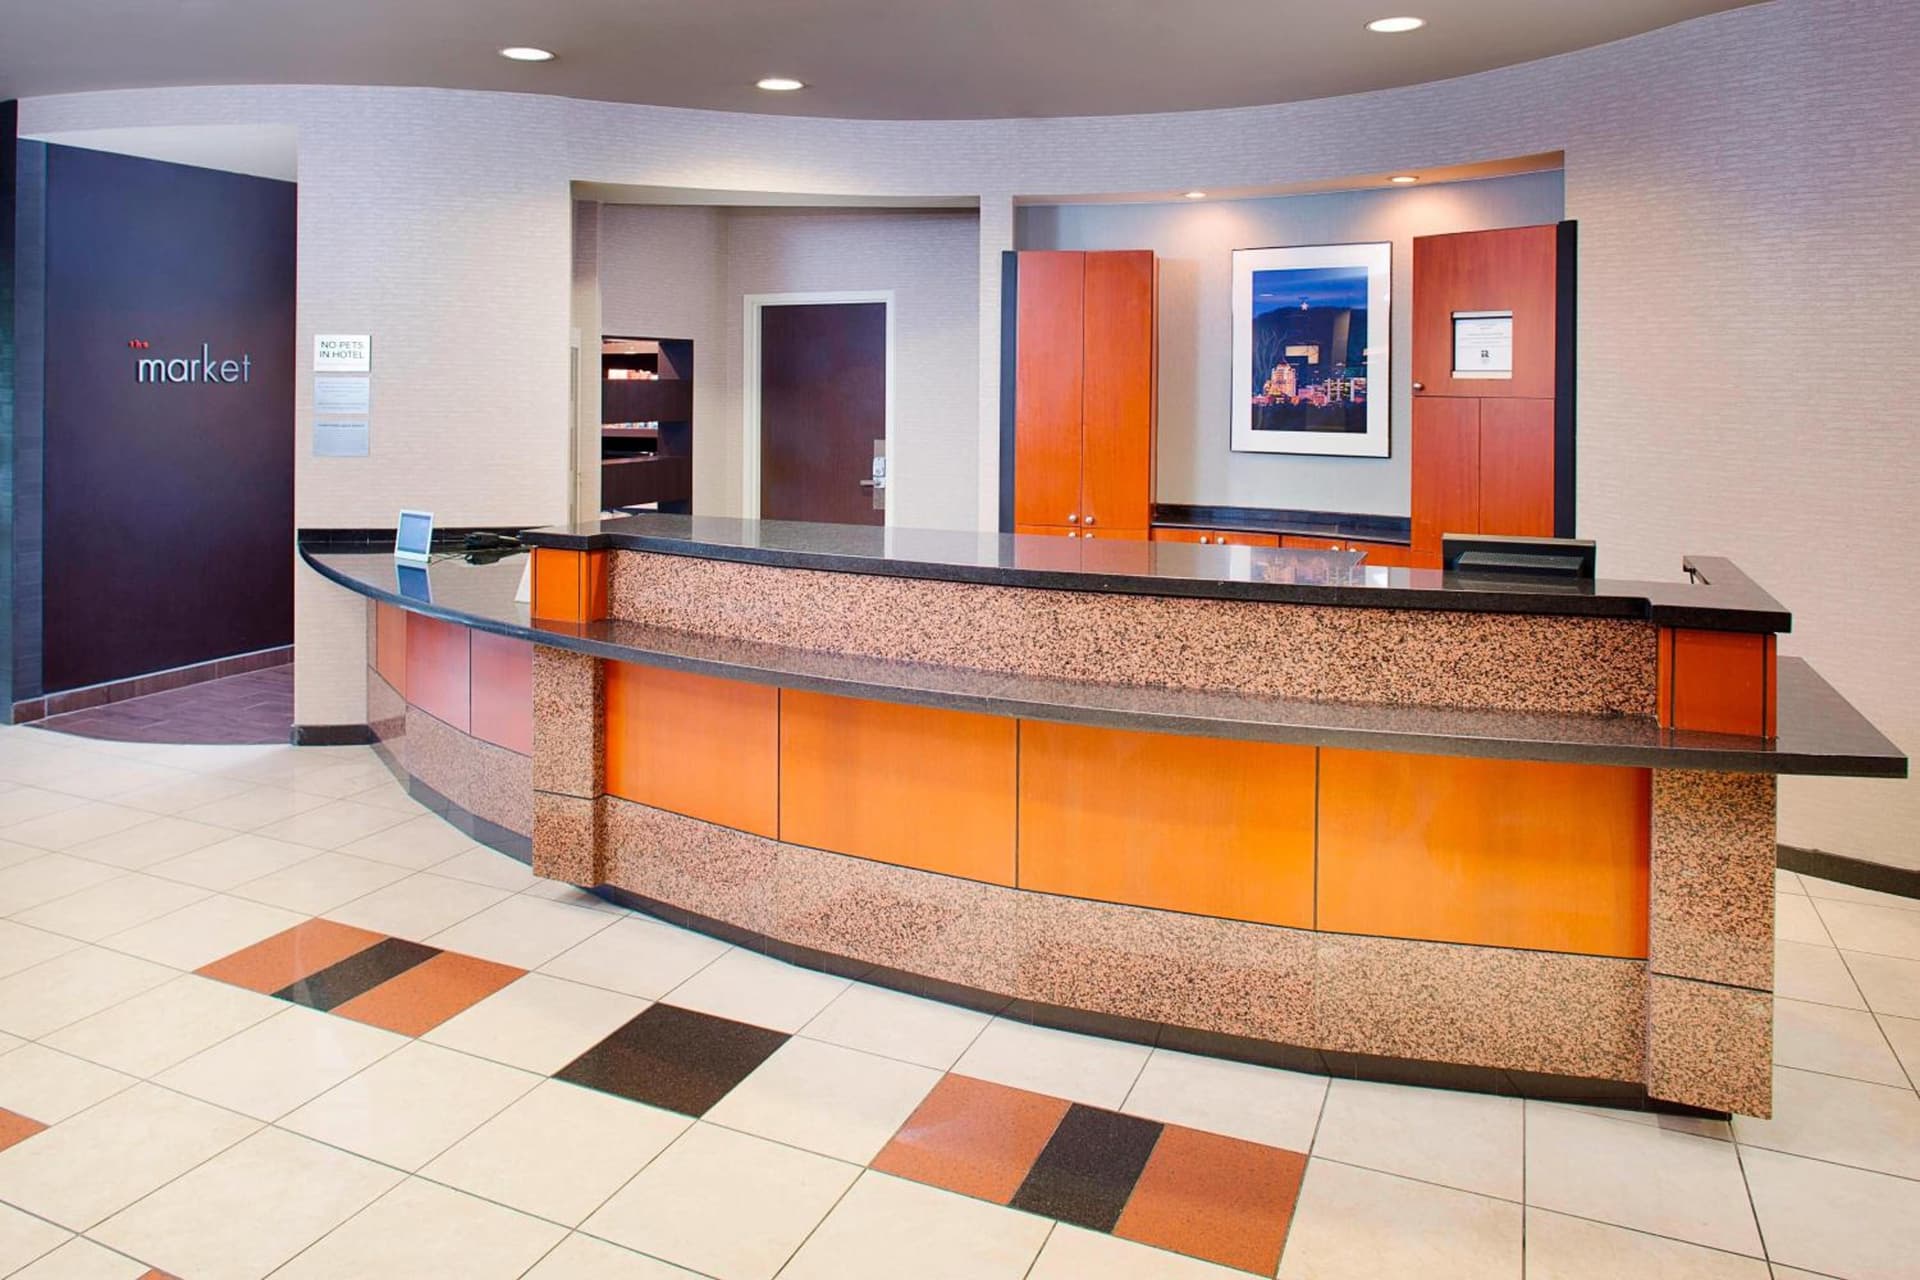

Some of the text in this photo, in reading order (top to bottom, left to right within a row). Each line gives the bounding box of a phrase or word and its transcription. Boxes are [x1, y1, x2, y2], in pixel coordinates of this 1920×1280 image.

[320, 340, 364, 350] NO PETS
[319, 350, 365, 359] IN HOTEL
[137, 343, 251, 383] market
